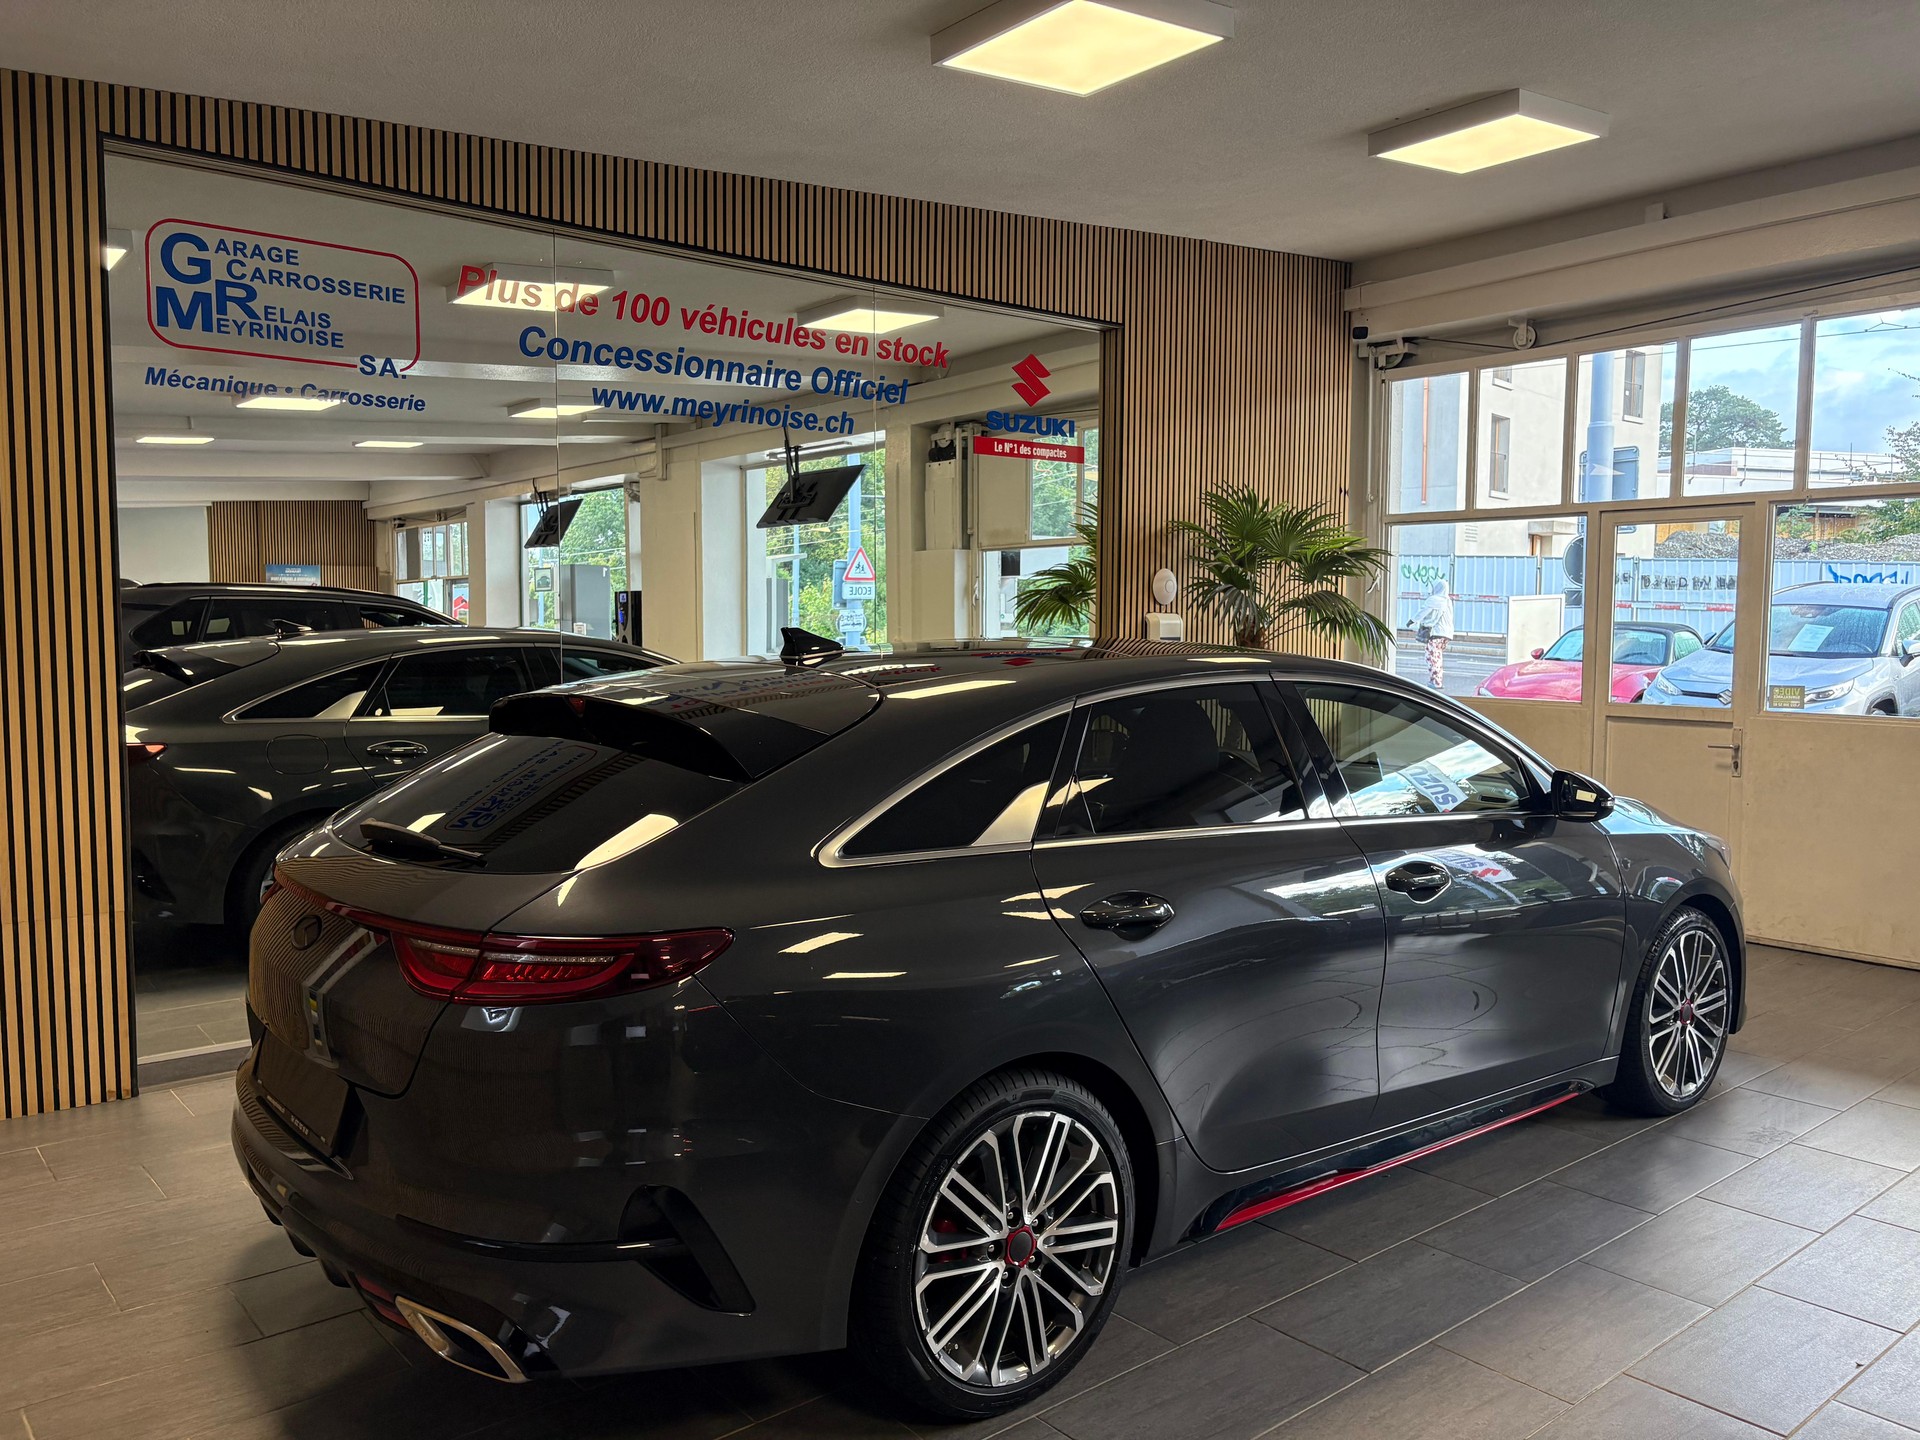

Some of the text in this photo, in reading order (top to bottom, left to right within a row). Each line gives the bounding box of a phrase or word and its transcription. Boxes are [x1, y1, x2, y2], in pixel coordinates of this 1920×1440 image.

[160, 232, 299, 284] GARAGE
[226, 259, 405, 304] CARROSSERIE
[156, 286, 344, 348] MEYRINOISE
[215, 279, 332, 329] RELAIS
[456, 264, 949, 368] Plus de 100 véhicules en stock
[145, 366, 426, 411] Mécanique Carrosserie
[519, 326, 908, 404] Concessionnaire Officiel
[592, 387, 854, 435] www.meyrinoise.ch
[986, 411, 1075, 438] SUZUKI
[994, 442, 1002, 453] Le
[1020, 444, 1031, 455] des
[1033, 446, 1067, 459] compactes
